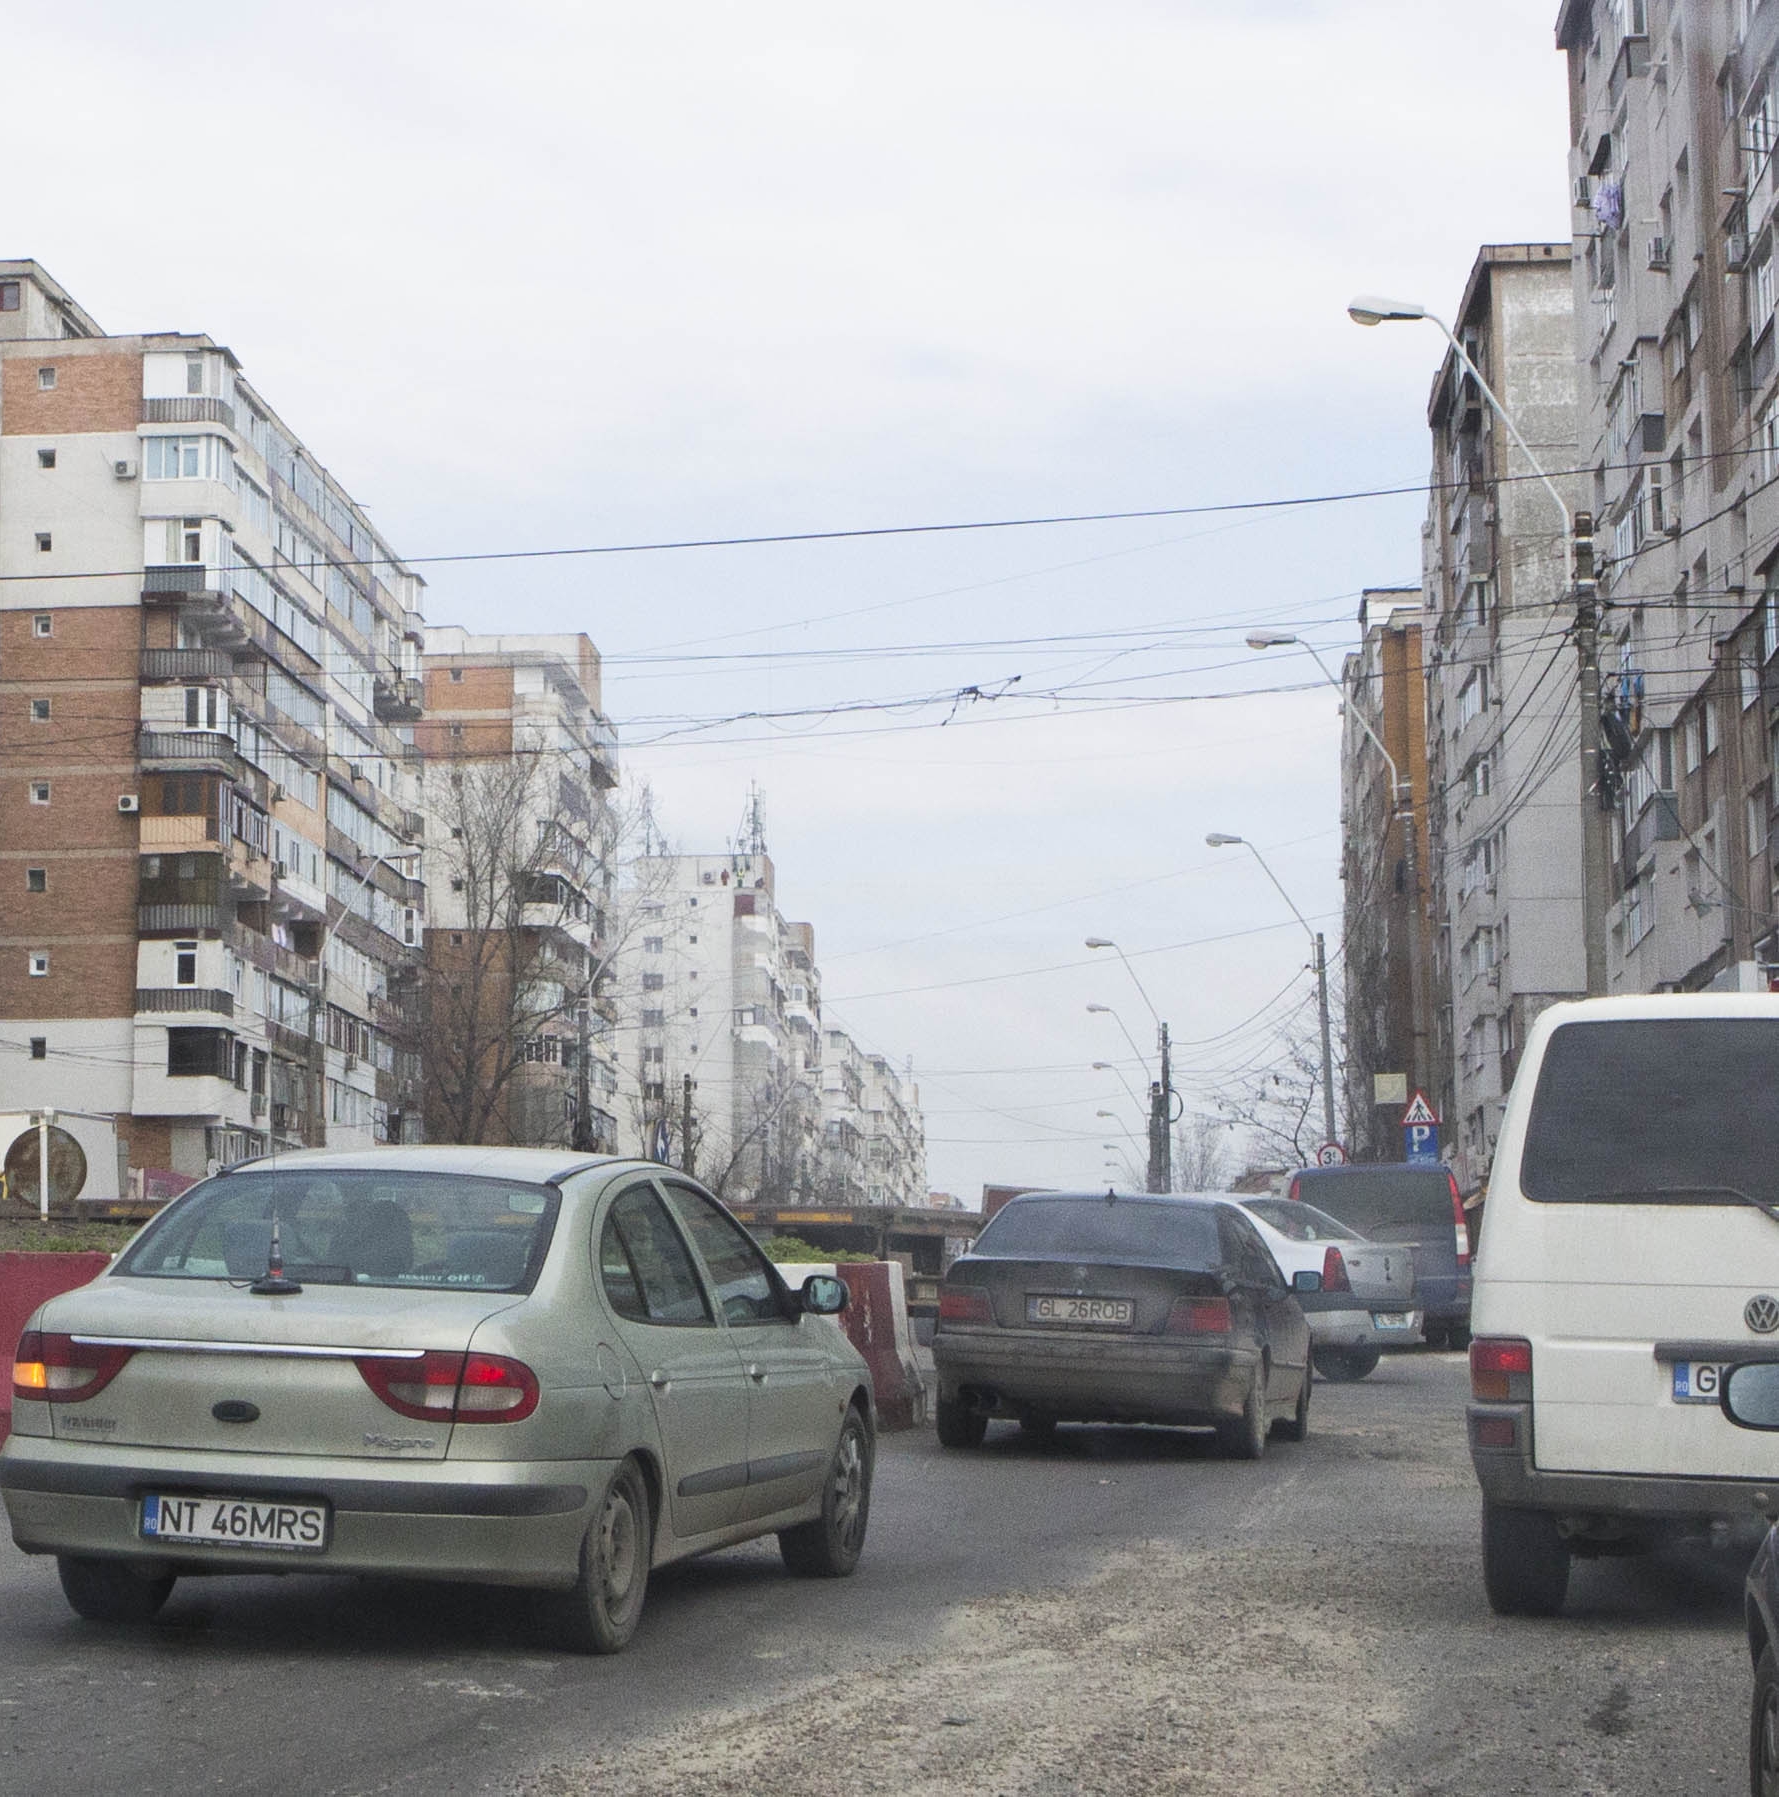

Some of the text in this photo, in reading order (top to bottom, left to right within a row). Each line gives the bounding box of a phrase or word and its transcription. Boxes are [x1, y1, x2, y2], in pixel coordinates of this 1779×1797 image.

[1411, 1125, 1430, 1153] P
[1039, 1300, 1128, 1320] GL 26ROB
[144, 1517, 157, 1530] RO
[160, 1500, 321, 1542] NT 46MRS
